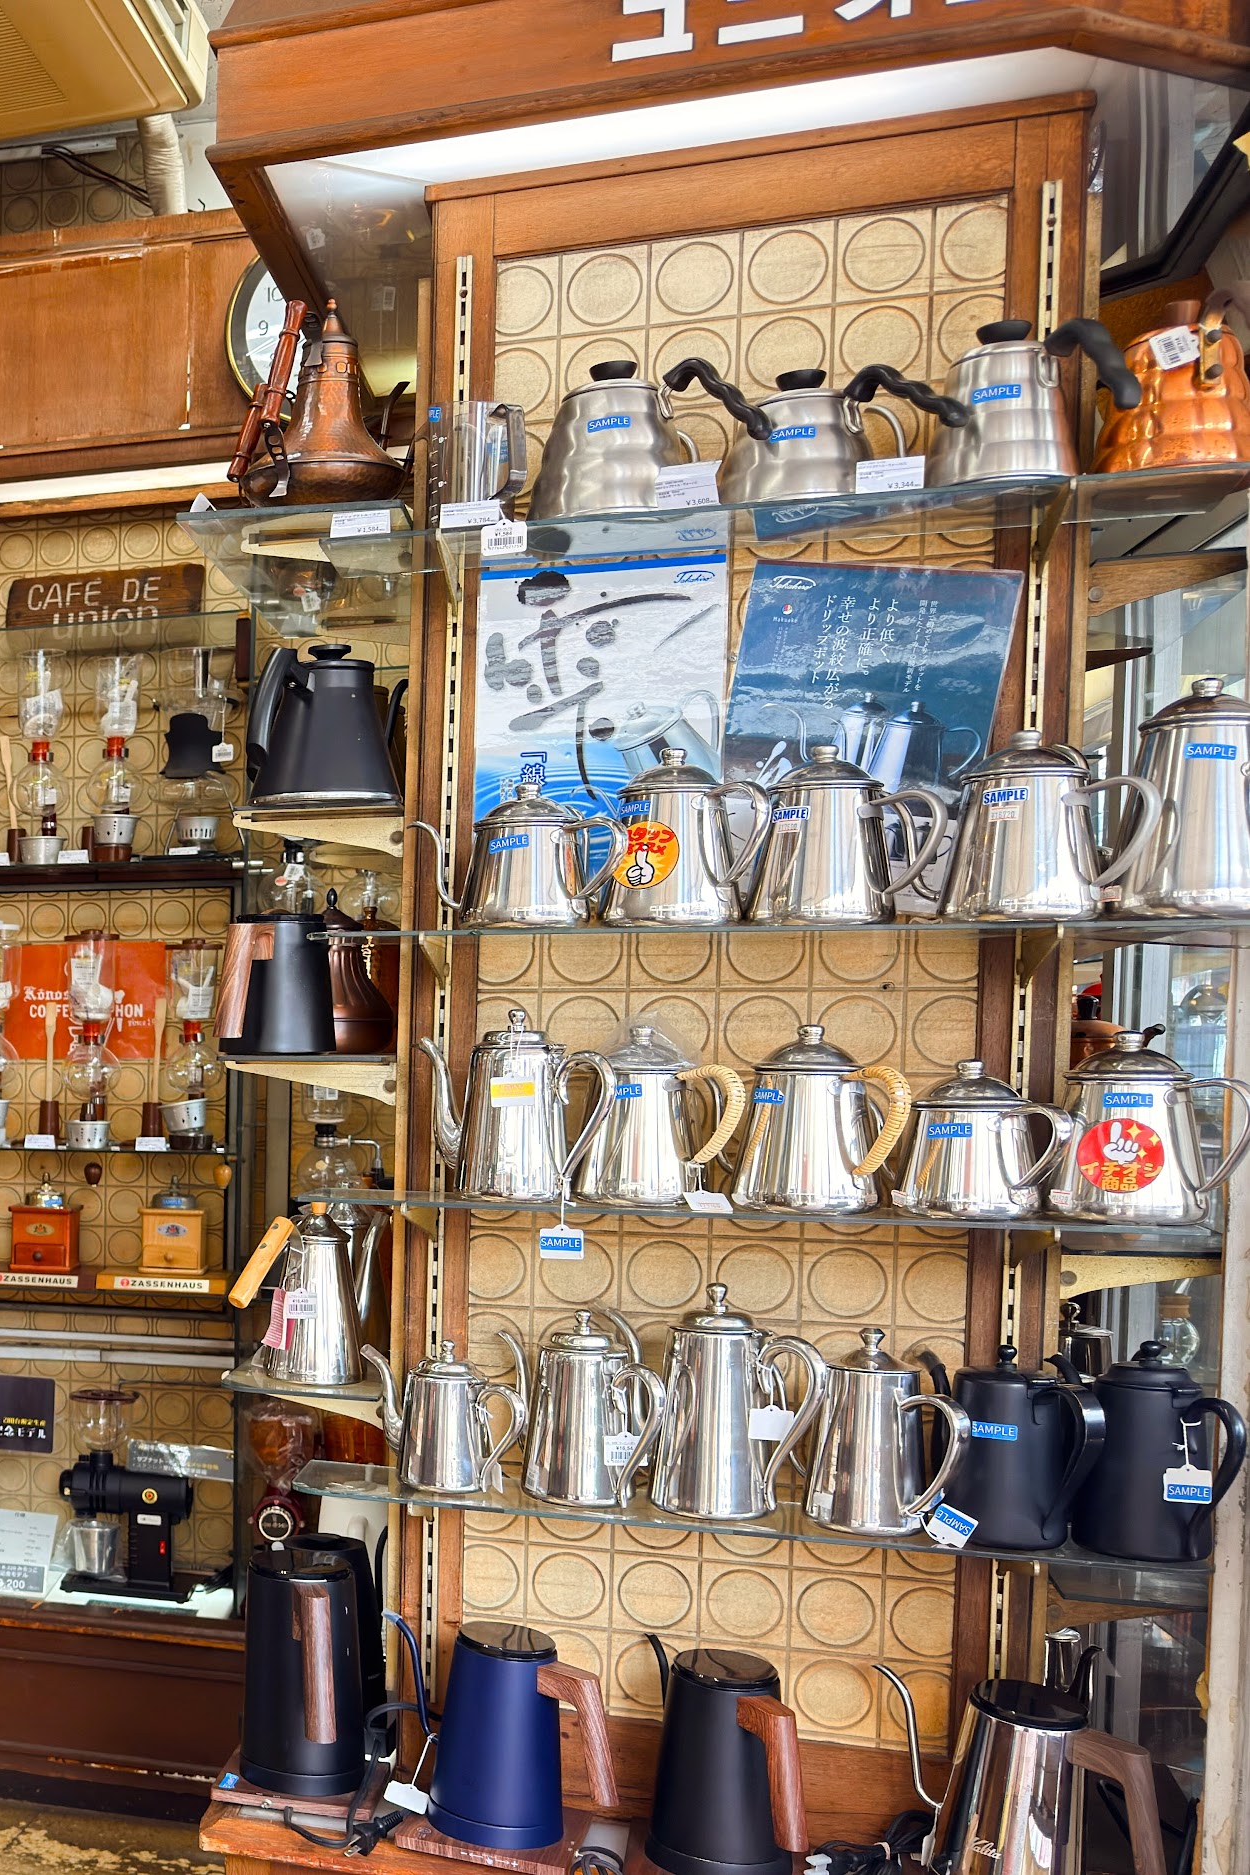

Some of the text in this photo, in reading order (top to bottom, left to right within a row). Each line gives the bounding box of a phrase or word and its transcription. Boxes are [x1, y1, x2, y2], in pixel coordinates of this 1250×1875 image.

[973, 386, 1020, 401] SAMPLE
[588, 417, 630, 430] SAMPLE
[771, 427, 815, 440] SAMPLE
[887, 481, 914, 489] ¥3,344
[685, 498, 710, 506] ¥3,608
[122, 576, 162, 603] DE
[52, 604, 159, 640] union
[856, 598, 881, 677] より正確に。
[879, 599, 899, 664] より低く、
[811, 594, 837, 685] ドリップポット
[822, 596, 857, 710] 幸せの波紋広がる
[1186, 746, 1236, 757] SAMPLE
[983, 789, 1028, 804] SAMPLE
[620, 803, 649, 815] SAMPLE
[772, 808, 807, 821] SAMPLE
[490, 835, 529, 851] SAMPLE
[615, 1085, 641, 1097] MPLE
[754, 1090, 784, 1102] SAMPLE
[1105, 1095, 1153, 1105] SAMPLE
[928, 1125, 971, 1136] SAMPLE
[1080, 1162, 1162, 1178] イチオシ
[1101, 1176, 1139, 1191] 商品
[540, 1237, 581, 1248] SAMPLE
[3, 1275, 73, 1286] ZASSENHAUS
[130, 1280, 203, 1290] ZASSENHAUS
[972, 1421, 1016, 1437] SAMPLE
[1168, 1485, 1210, 1498] SAMPLE
[935, 1508, 972, 1536] SAMPLE
